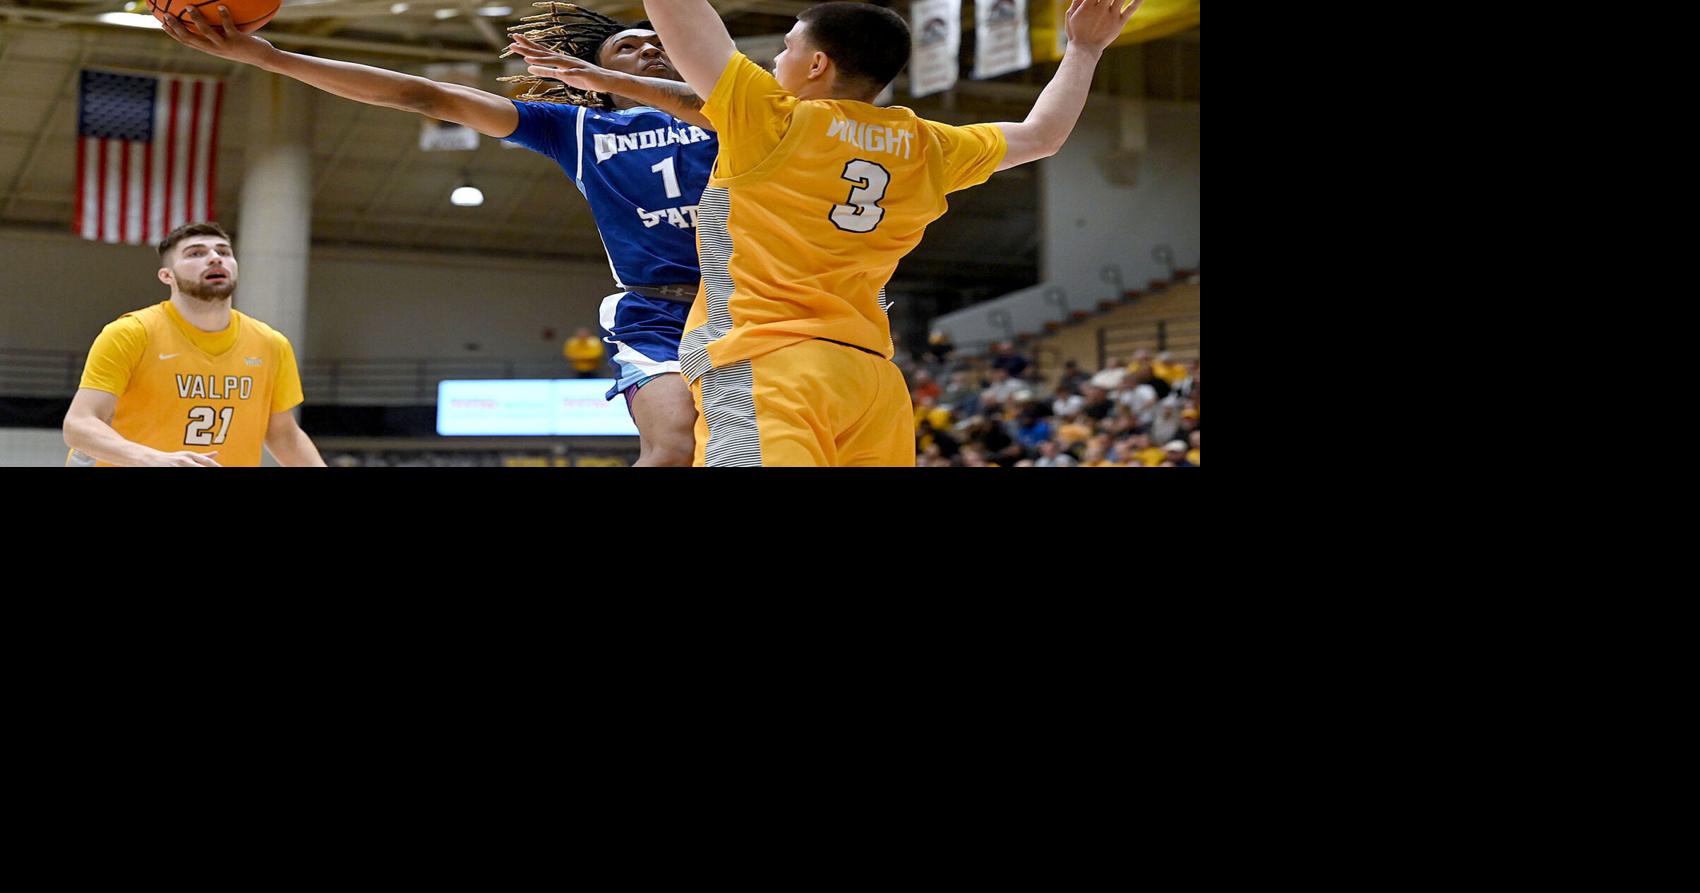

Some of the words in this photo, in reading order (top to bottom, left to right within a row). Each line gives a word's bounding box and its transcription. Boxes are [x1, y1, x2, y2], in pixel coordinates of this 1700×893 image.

[652, 156, 681, 199] 1
[828, 158, 891, 233] 3
[636, 205, 699, 228] STAT
[176, 374, 253, 400] VALPO
[183, 405, 234, 446] 21
